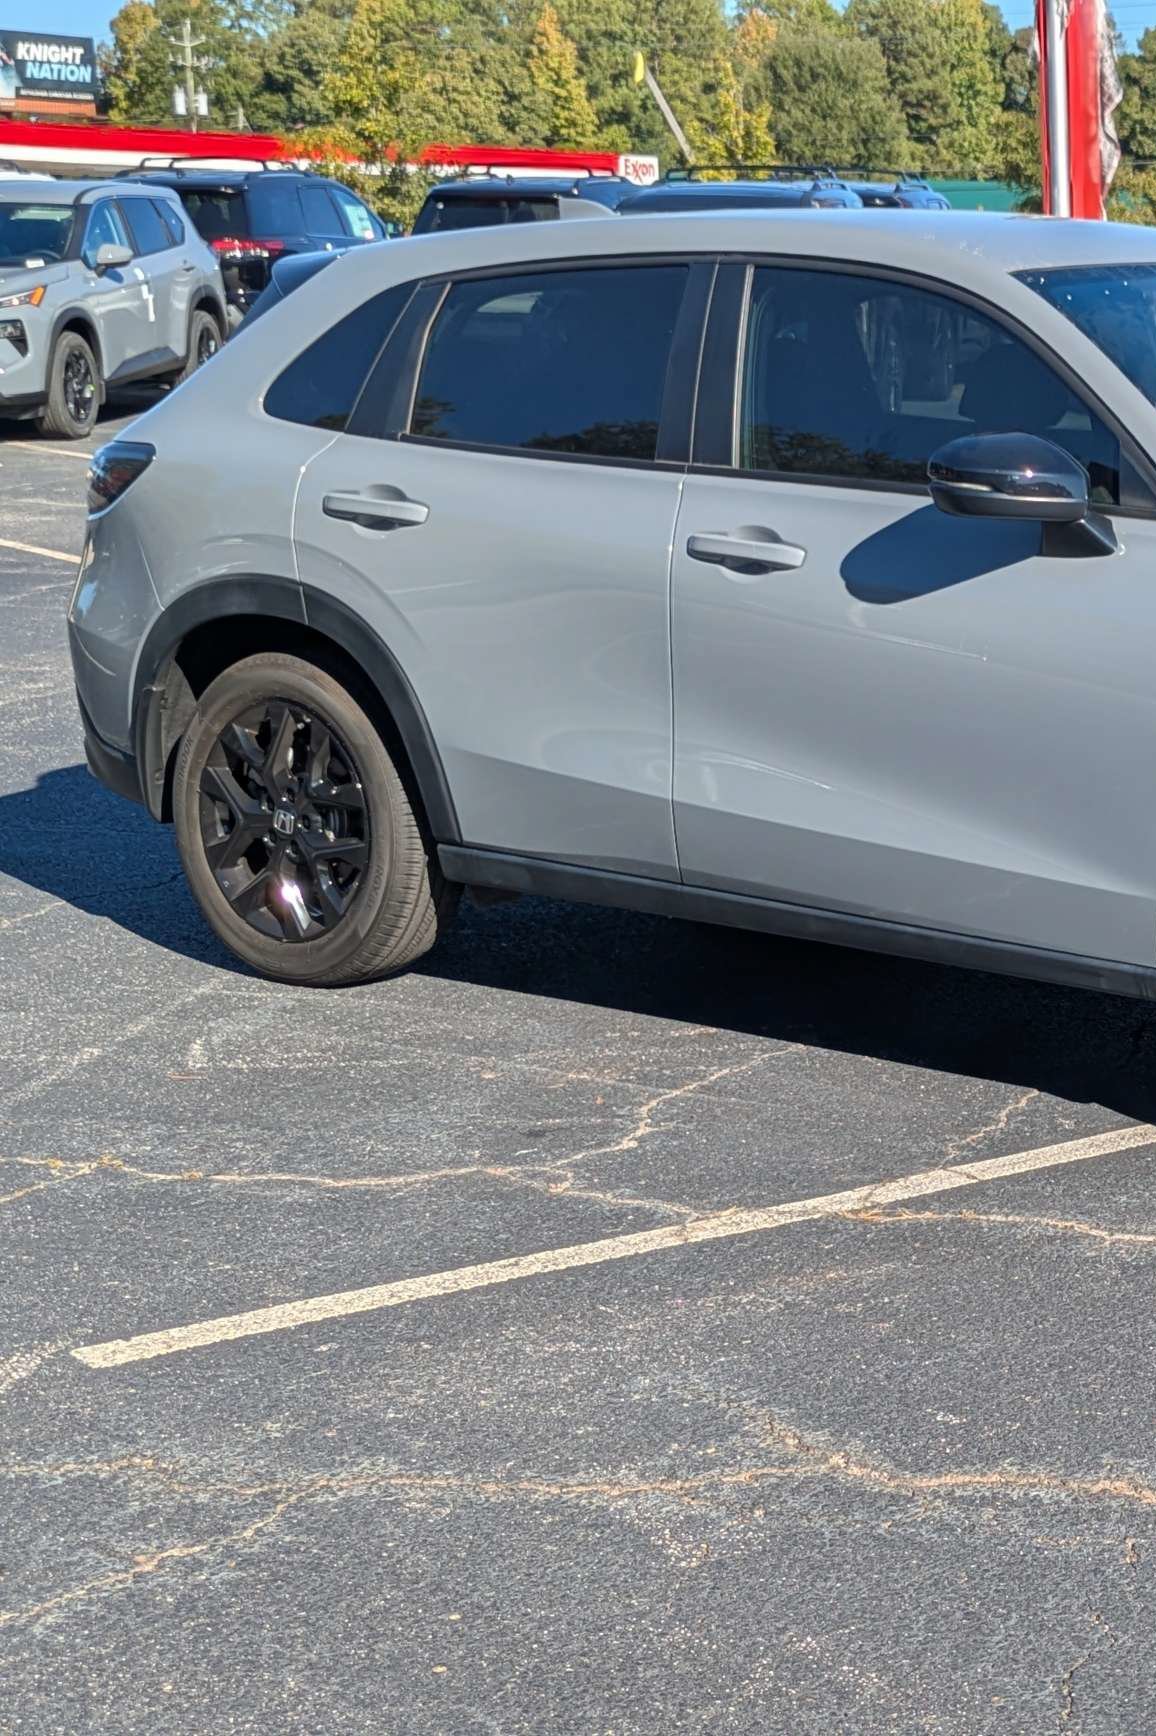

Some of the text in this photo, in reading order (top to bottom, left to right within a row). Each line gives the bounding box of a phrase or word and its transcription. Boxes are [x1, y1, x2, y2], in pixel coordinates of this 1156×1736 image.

[16, 41, 84, 65] KNIGHT
[25, 61, 92, 83] NATION
[624, 158, 655, 184] Exxon
